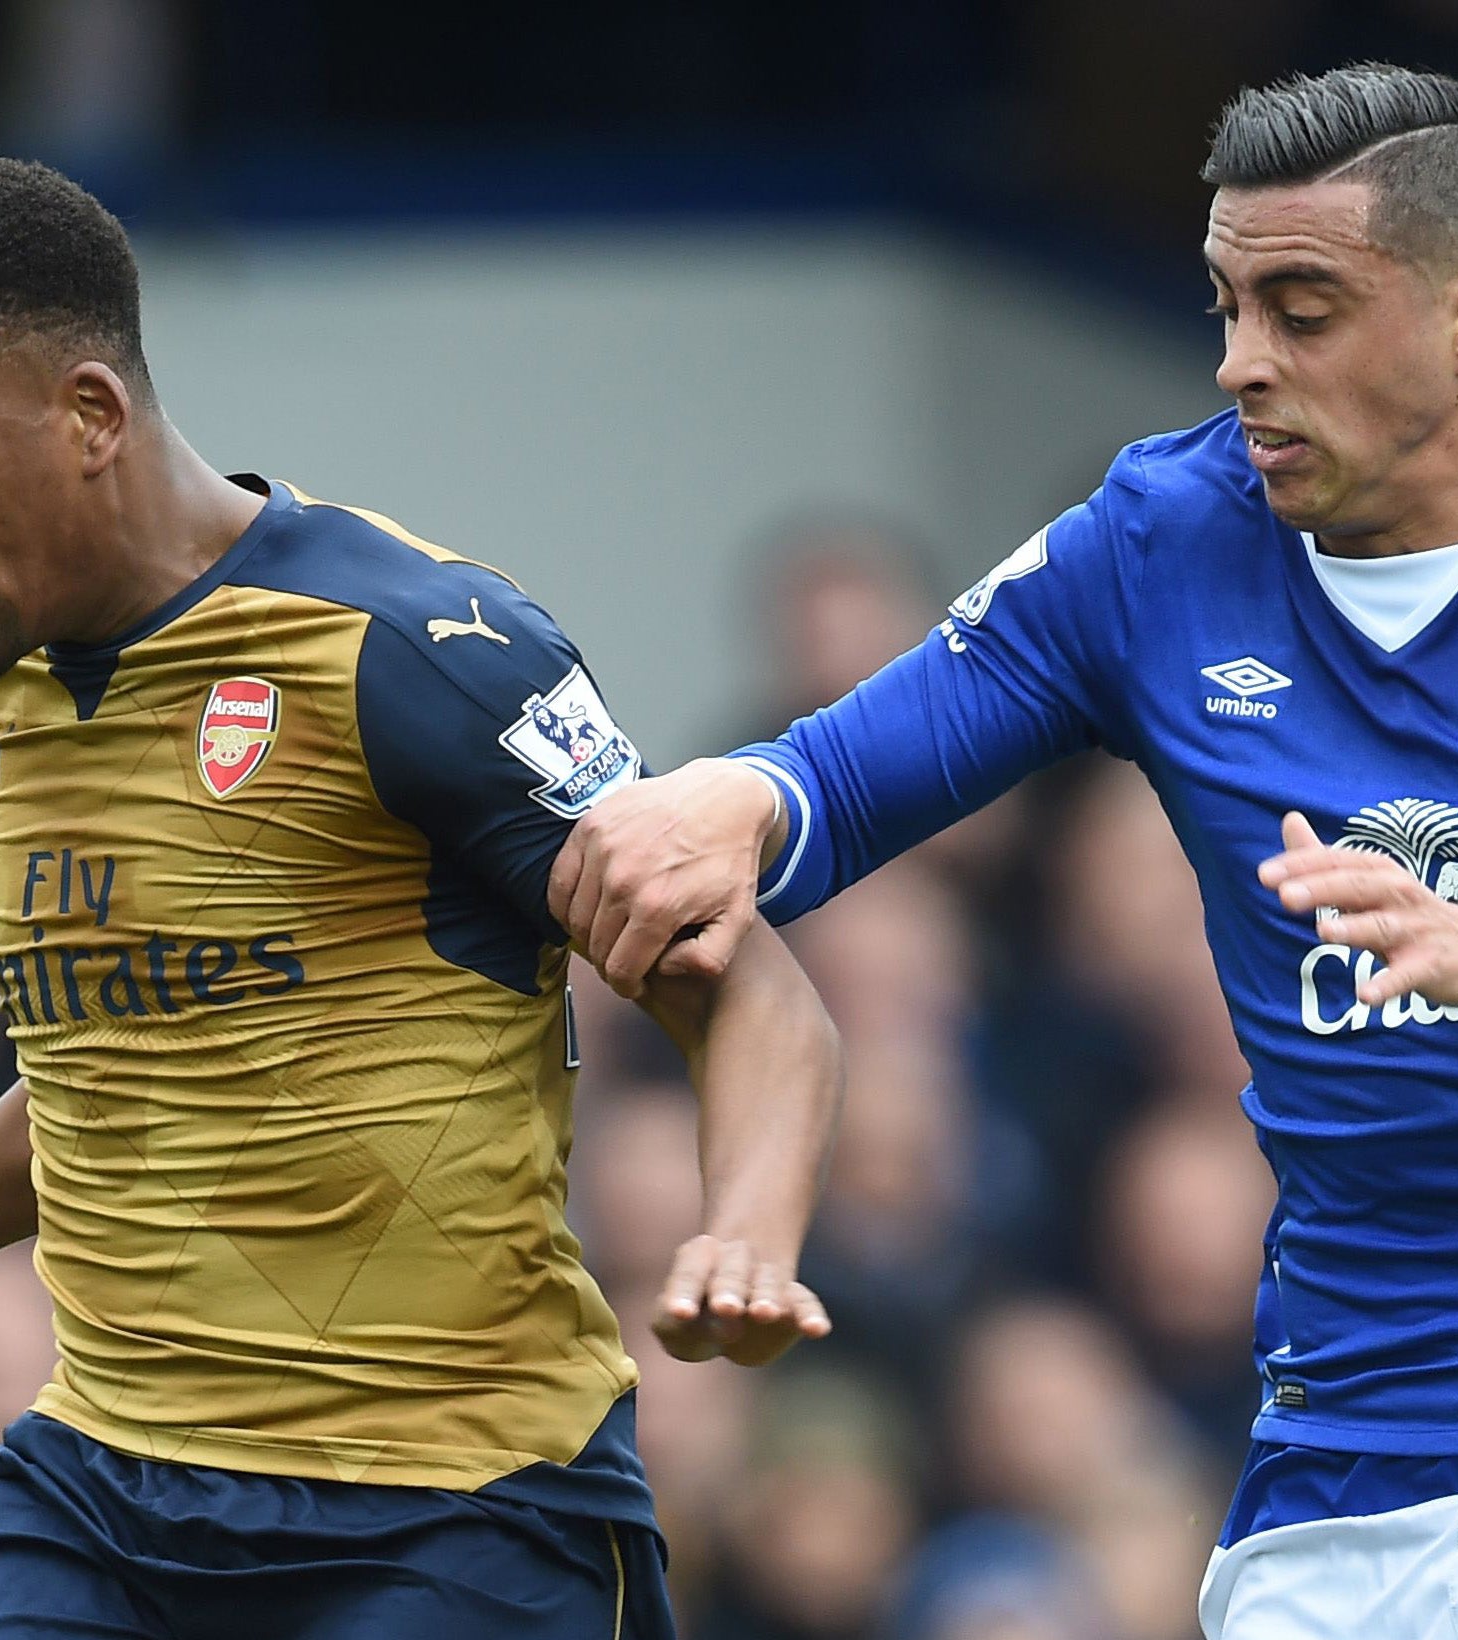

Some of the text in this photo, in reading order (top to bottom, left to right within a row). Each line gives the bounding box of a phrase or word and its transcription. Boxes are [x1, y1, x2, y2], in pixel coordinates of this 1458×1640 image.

[209, 696, 269, 717] Arsenal
[1206, 696, 1277, 719] umbro
[564, 743, 620, 797] BARCLAYS
[21, 848, 116, 927] Fly
